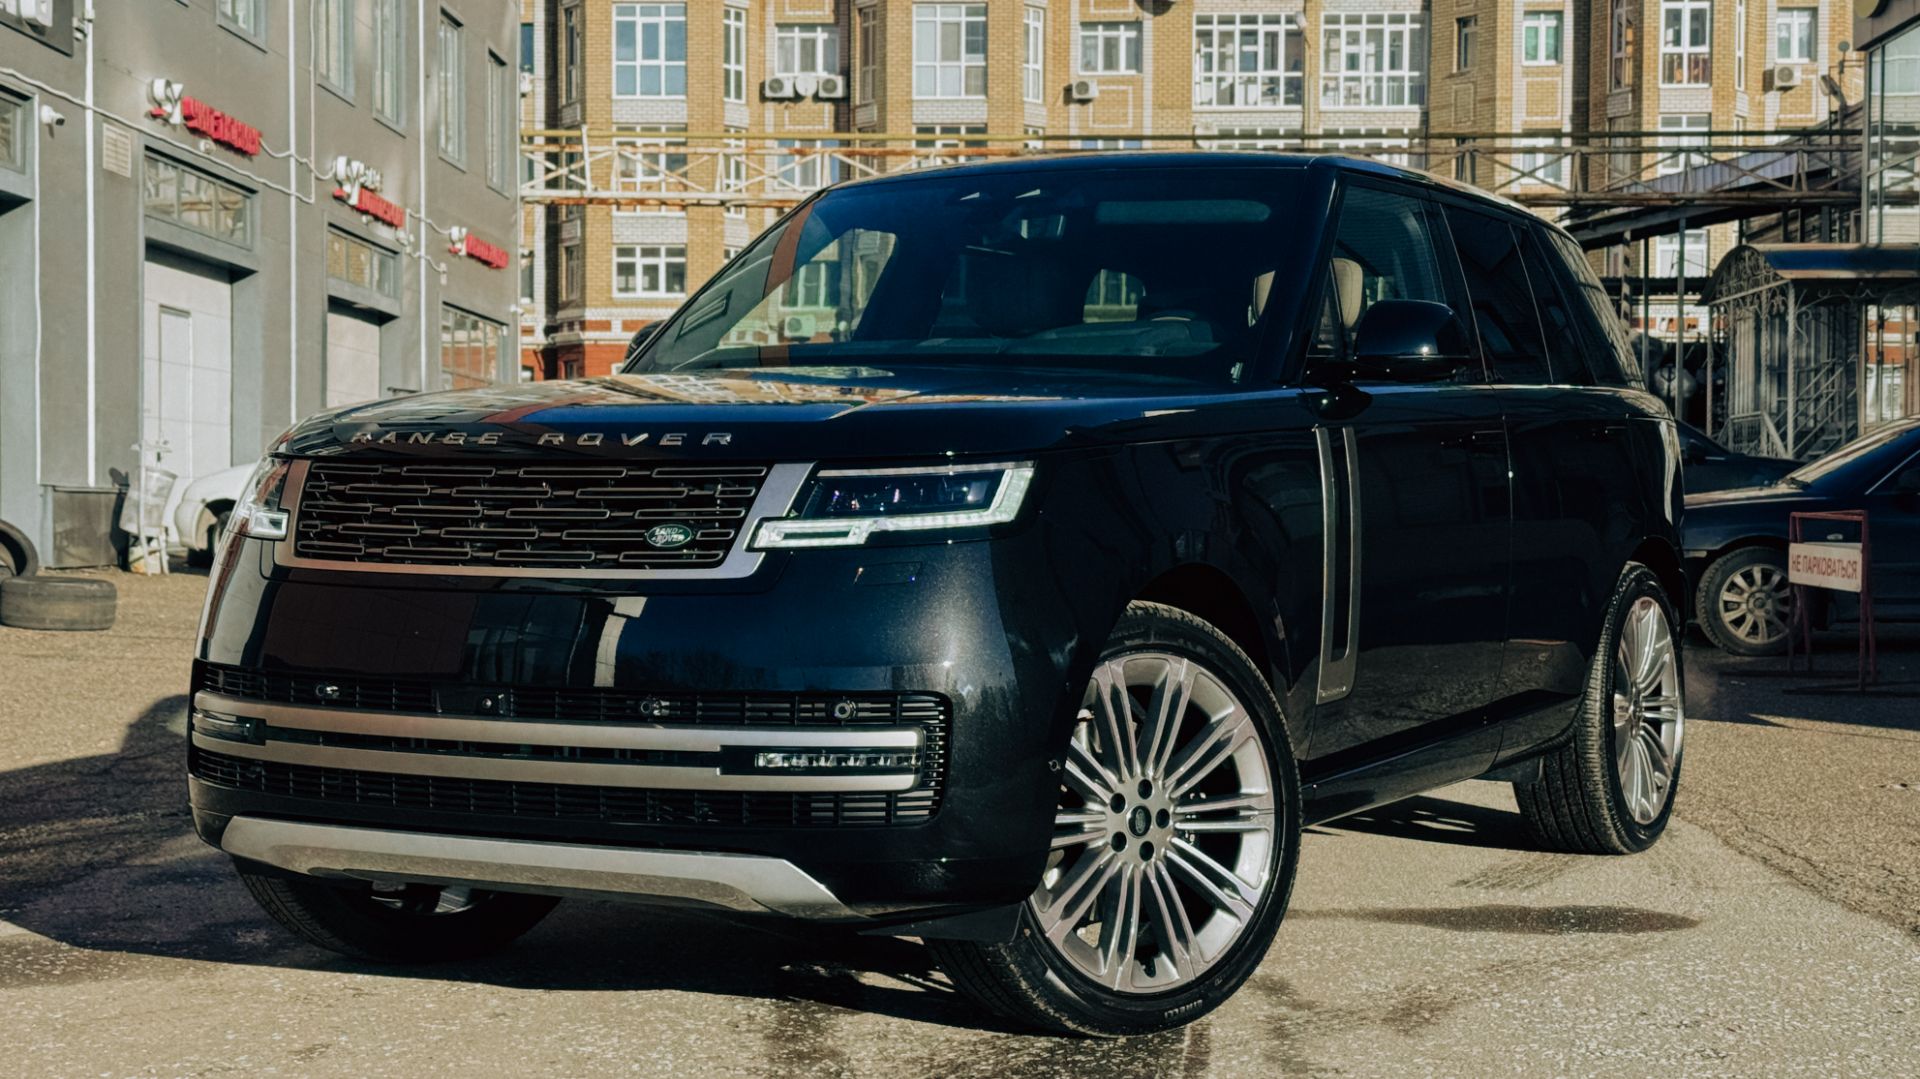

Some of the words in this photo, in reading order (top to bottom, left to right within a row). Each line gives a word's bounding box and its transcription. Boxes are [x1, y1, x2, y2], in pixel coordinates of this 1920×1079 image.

[351, 431, 503, 445] RANGE
[537, 432, 732, 446] ROVER
[655, 527, 678, 535] LAND
[1791, 554, 1801, 573] НЕ
[1802, 555, 1858, 580] ПАРКОВАТЬСЯ
